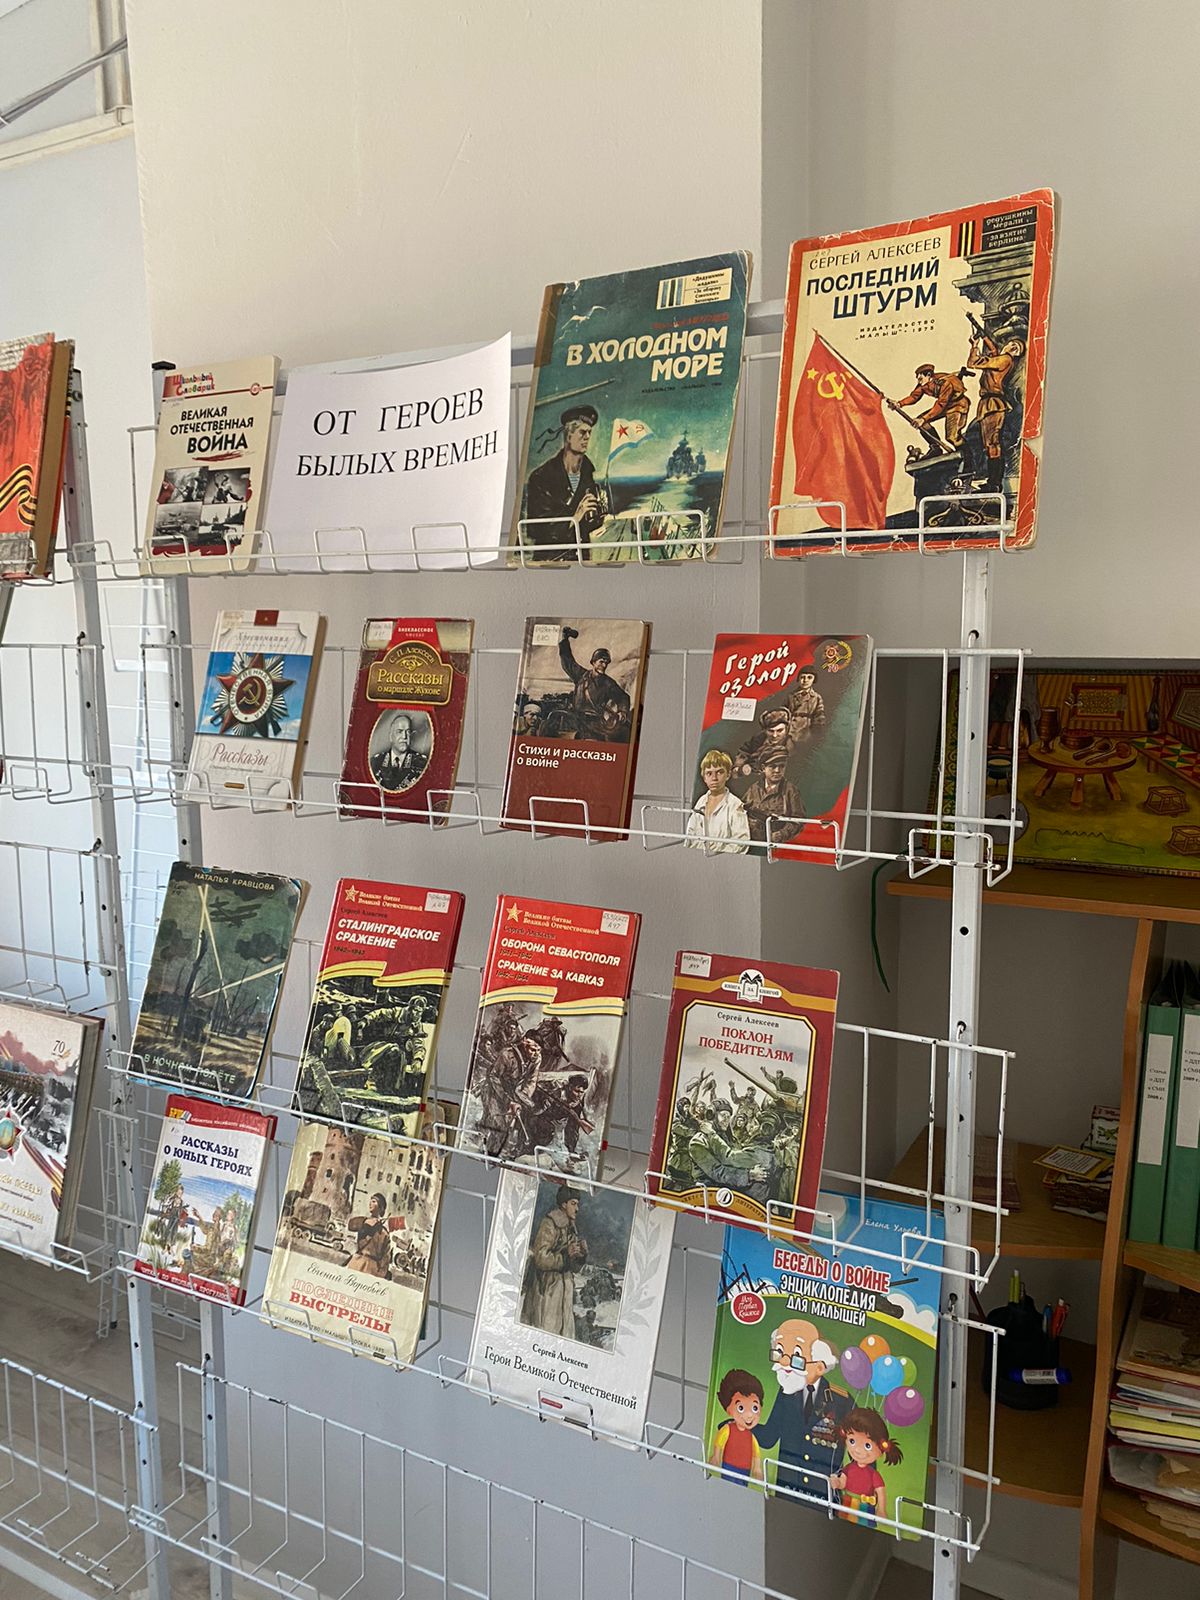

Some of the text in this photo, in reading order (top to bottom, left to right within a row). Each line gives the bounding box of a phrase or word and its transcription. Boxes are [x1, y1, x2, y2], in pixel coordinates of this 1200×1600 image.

[809, 250, 860, 270] СЕРГЕЙ
[866, 237, 942, 261] АЛЕКСЕЕВ
[806, 256, 940, 297] ПОСЛЕДНИЙ
[832, 282, 938, 319] ШТУРМ
[860, 319, 935, 332] ИЗДАТЕЛЬСТВО
[566, 326, 728, 366] В ХОЛОДНОМ
[651, 352, 724, 382] МОРЕ
[181, 406, 228, 421] ВЕЛИКАЯ
[313, 387, 484, 436] ОТ ГЕРОЕВ
[170, 417, 254, 435] ОТЕЧЕСТВЕННАЯ
[187, 431, 248, 453] ВОЙНА
[296, 430, 500, 476] БЫЛЫХ ВРЕМЕН
[377, 668, 444, 685] Рассказы
[210, 742, 269, 766] Рассказы
[517, 756, 559, 769] о войне
[518, 742, 617, 763] Стихи и рассказы
[194, 873, 275, 890] НАТАЛЬЯ КРАВЦОВА
[335, 931, 398, 949] СРАЖЕНИЕ
[338, 918, 441, 942] СТАЛИНГРАДСКОЕ
[501, 938, 621, 967] ОБОРОНА СЕВАСТОПОЛЯ
[497, 959, 605, 987] СРАЖЕНИЕ ЗА КАВКАЗ
[717, 1011, 780, 1028] Сергей Алексеев
[53, 1040, 66, 1054] 70
[721, 1026, 774, 1045] ПОКЛОН
[144, 1054, 150, 1063] В
[699, 1036, 794, 1063] ПОБЕДИТЕЛЯМ
[181, 1135, 239, 1158] РАССКАЗЫ
[164, 1145, 253, 1177] О ЮНЫХ ГЕРОЯХ
[865, 1219, 890, 1230] Елена
[307, 1262, 342, 1282] Евгений
[773, 1248, 891, 1293] БЕСЕДЫ О ВОЙНЕ
[292, 1278, 395, 1321] ПОСЛЕДНИЕ
[780, 1273, 876, 1313] ЭНЦИКЛОПЕДИЯ
[289, 1291, 392, 1334] ВЫСТРЕЛЫ
[786, 1296, 867, 1328] ДЛЯ МАЛЫШЕЙ
[532, 1343, 589, 1369] Сергей Алексеев
[484, 1346, 512, 1367] Герои
[513, 1355, 556, 1382] Великой
[558, 1371, 637, 1410] Отечественной
